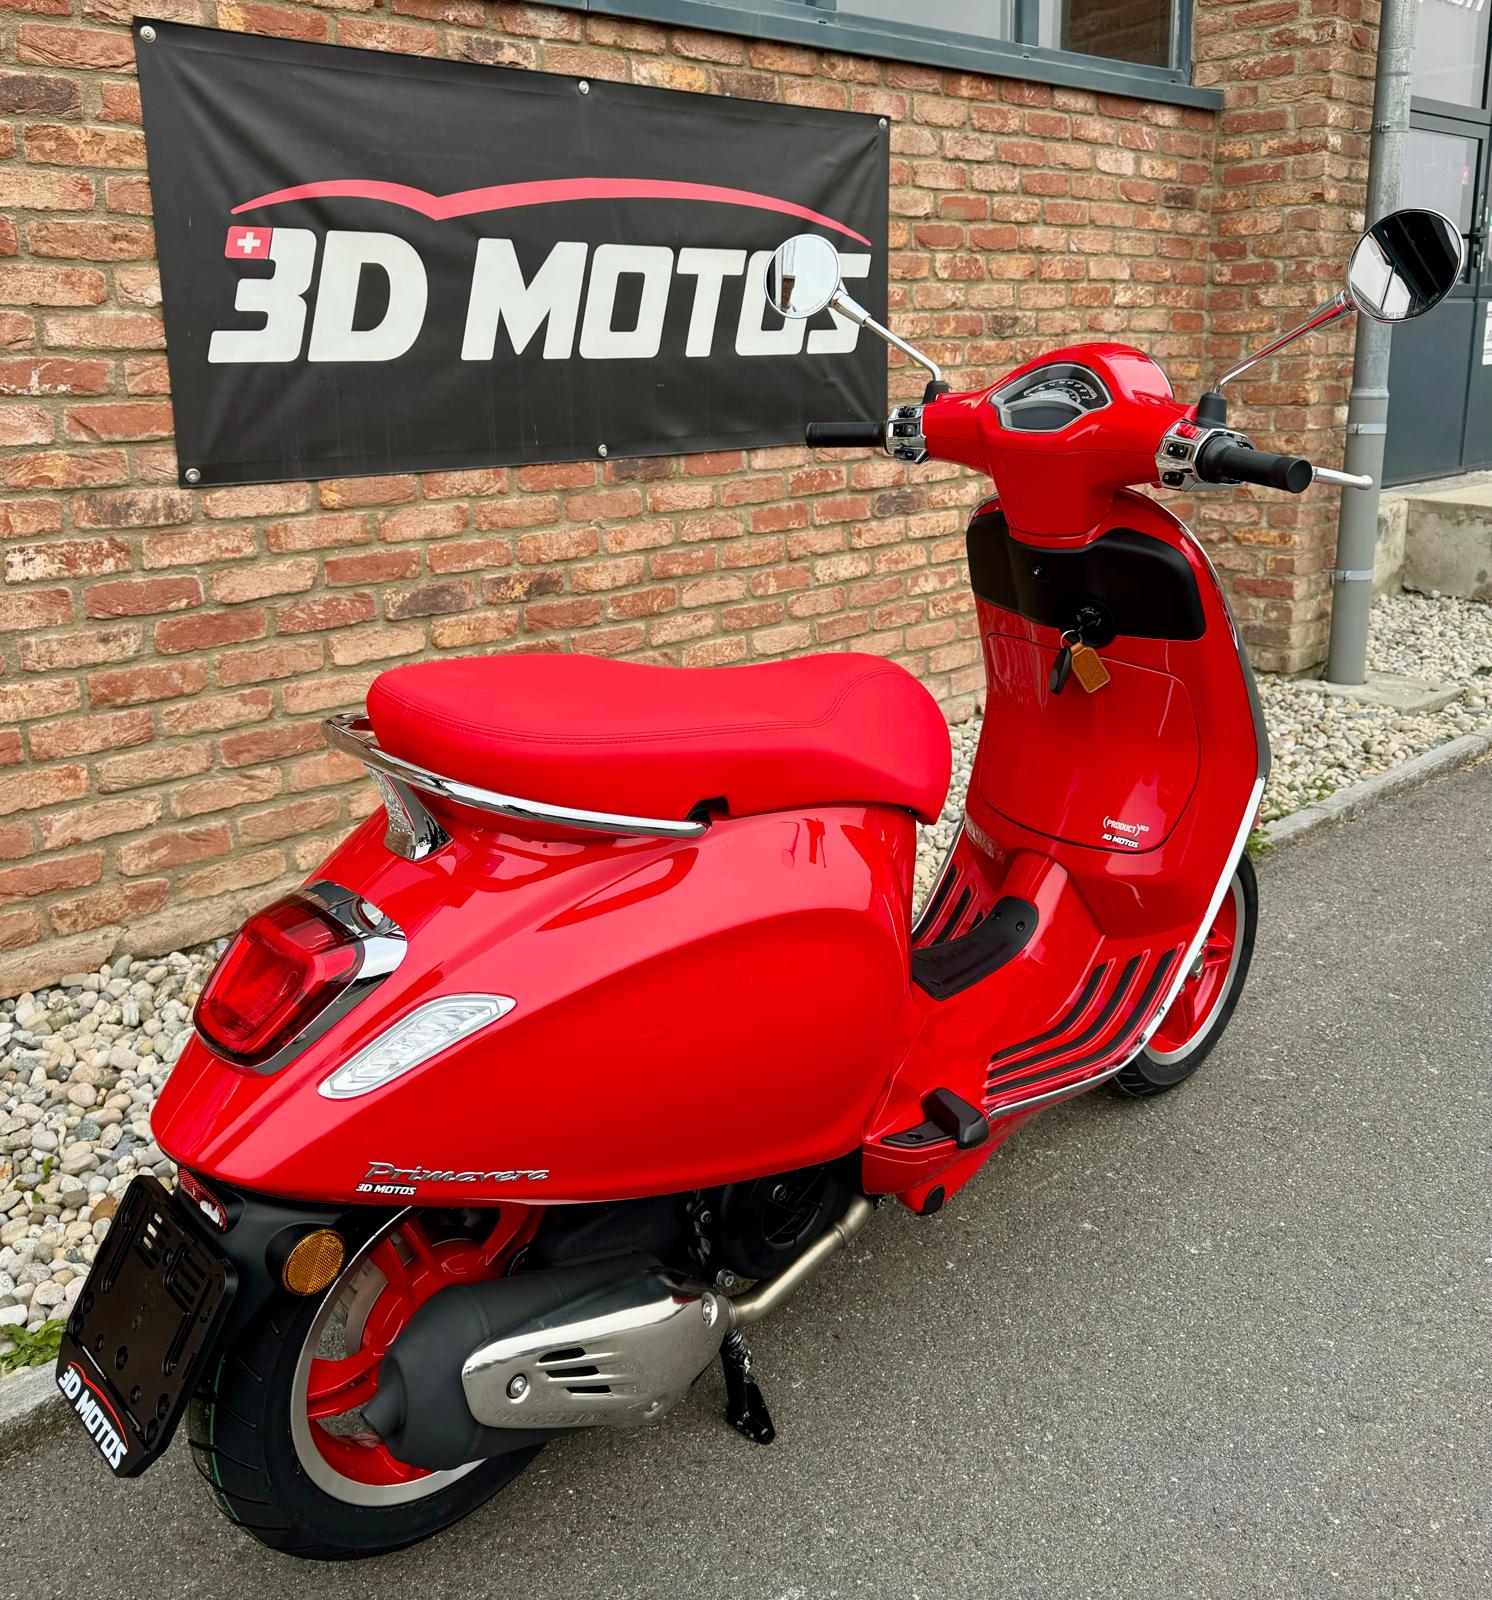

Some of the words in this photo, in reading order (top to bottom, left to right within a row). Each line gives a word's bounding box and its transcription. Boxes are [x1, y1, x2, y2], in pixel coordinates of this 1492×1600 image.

[207, 226, 429, 364] 3D
[460, 237, 872, 361] MOTOS
[1112, 835, 1140, 848] MOTOS
[364, 1161, 550, 1183] Primavera
[355, 1183, 373, 1192] 3D
[373, 1184, 417, 1196] MOTOS
[58, 1366, 81, 1400] 3D
[74, 1388, 128, 1470] MOTOS
